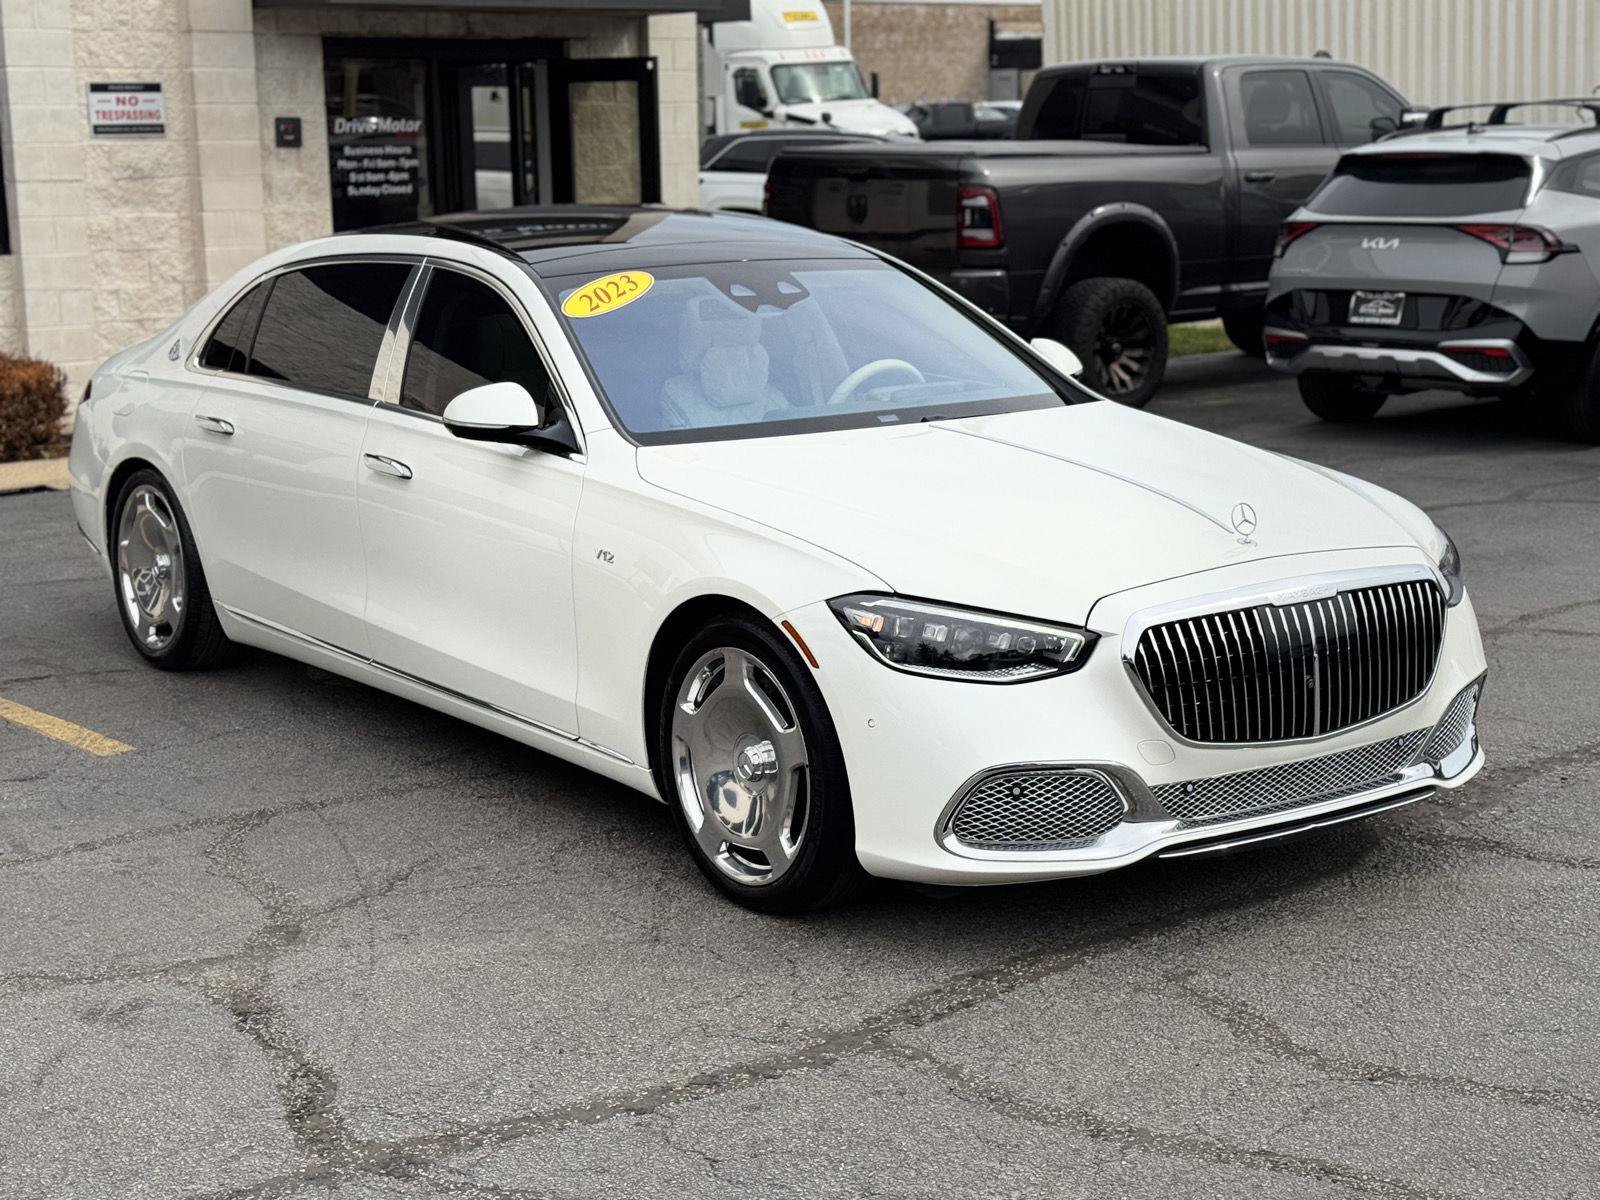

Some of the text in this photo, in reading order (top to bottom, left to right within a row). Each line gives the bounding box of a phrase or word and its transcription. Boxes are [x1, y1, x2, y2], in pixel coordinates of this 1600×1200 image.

[115, 95, 139, 107] NO
[95, 108, 162, 121] TRESPASSING
[334, 117, 423, 134] Drive Motor
[343, 145, 412, 156] Business Hours
[337, 159, 358, 170] Mon
[347, 183, 413, 197] Sunday Closed
[579, 275, 639, 312] 2023
